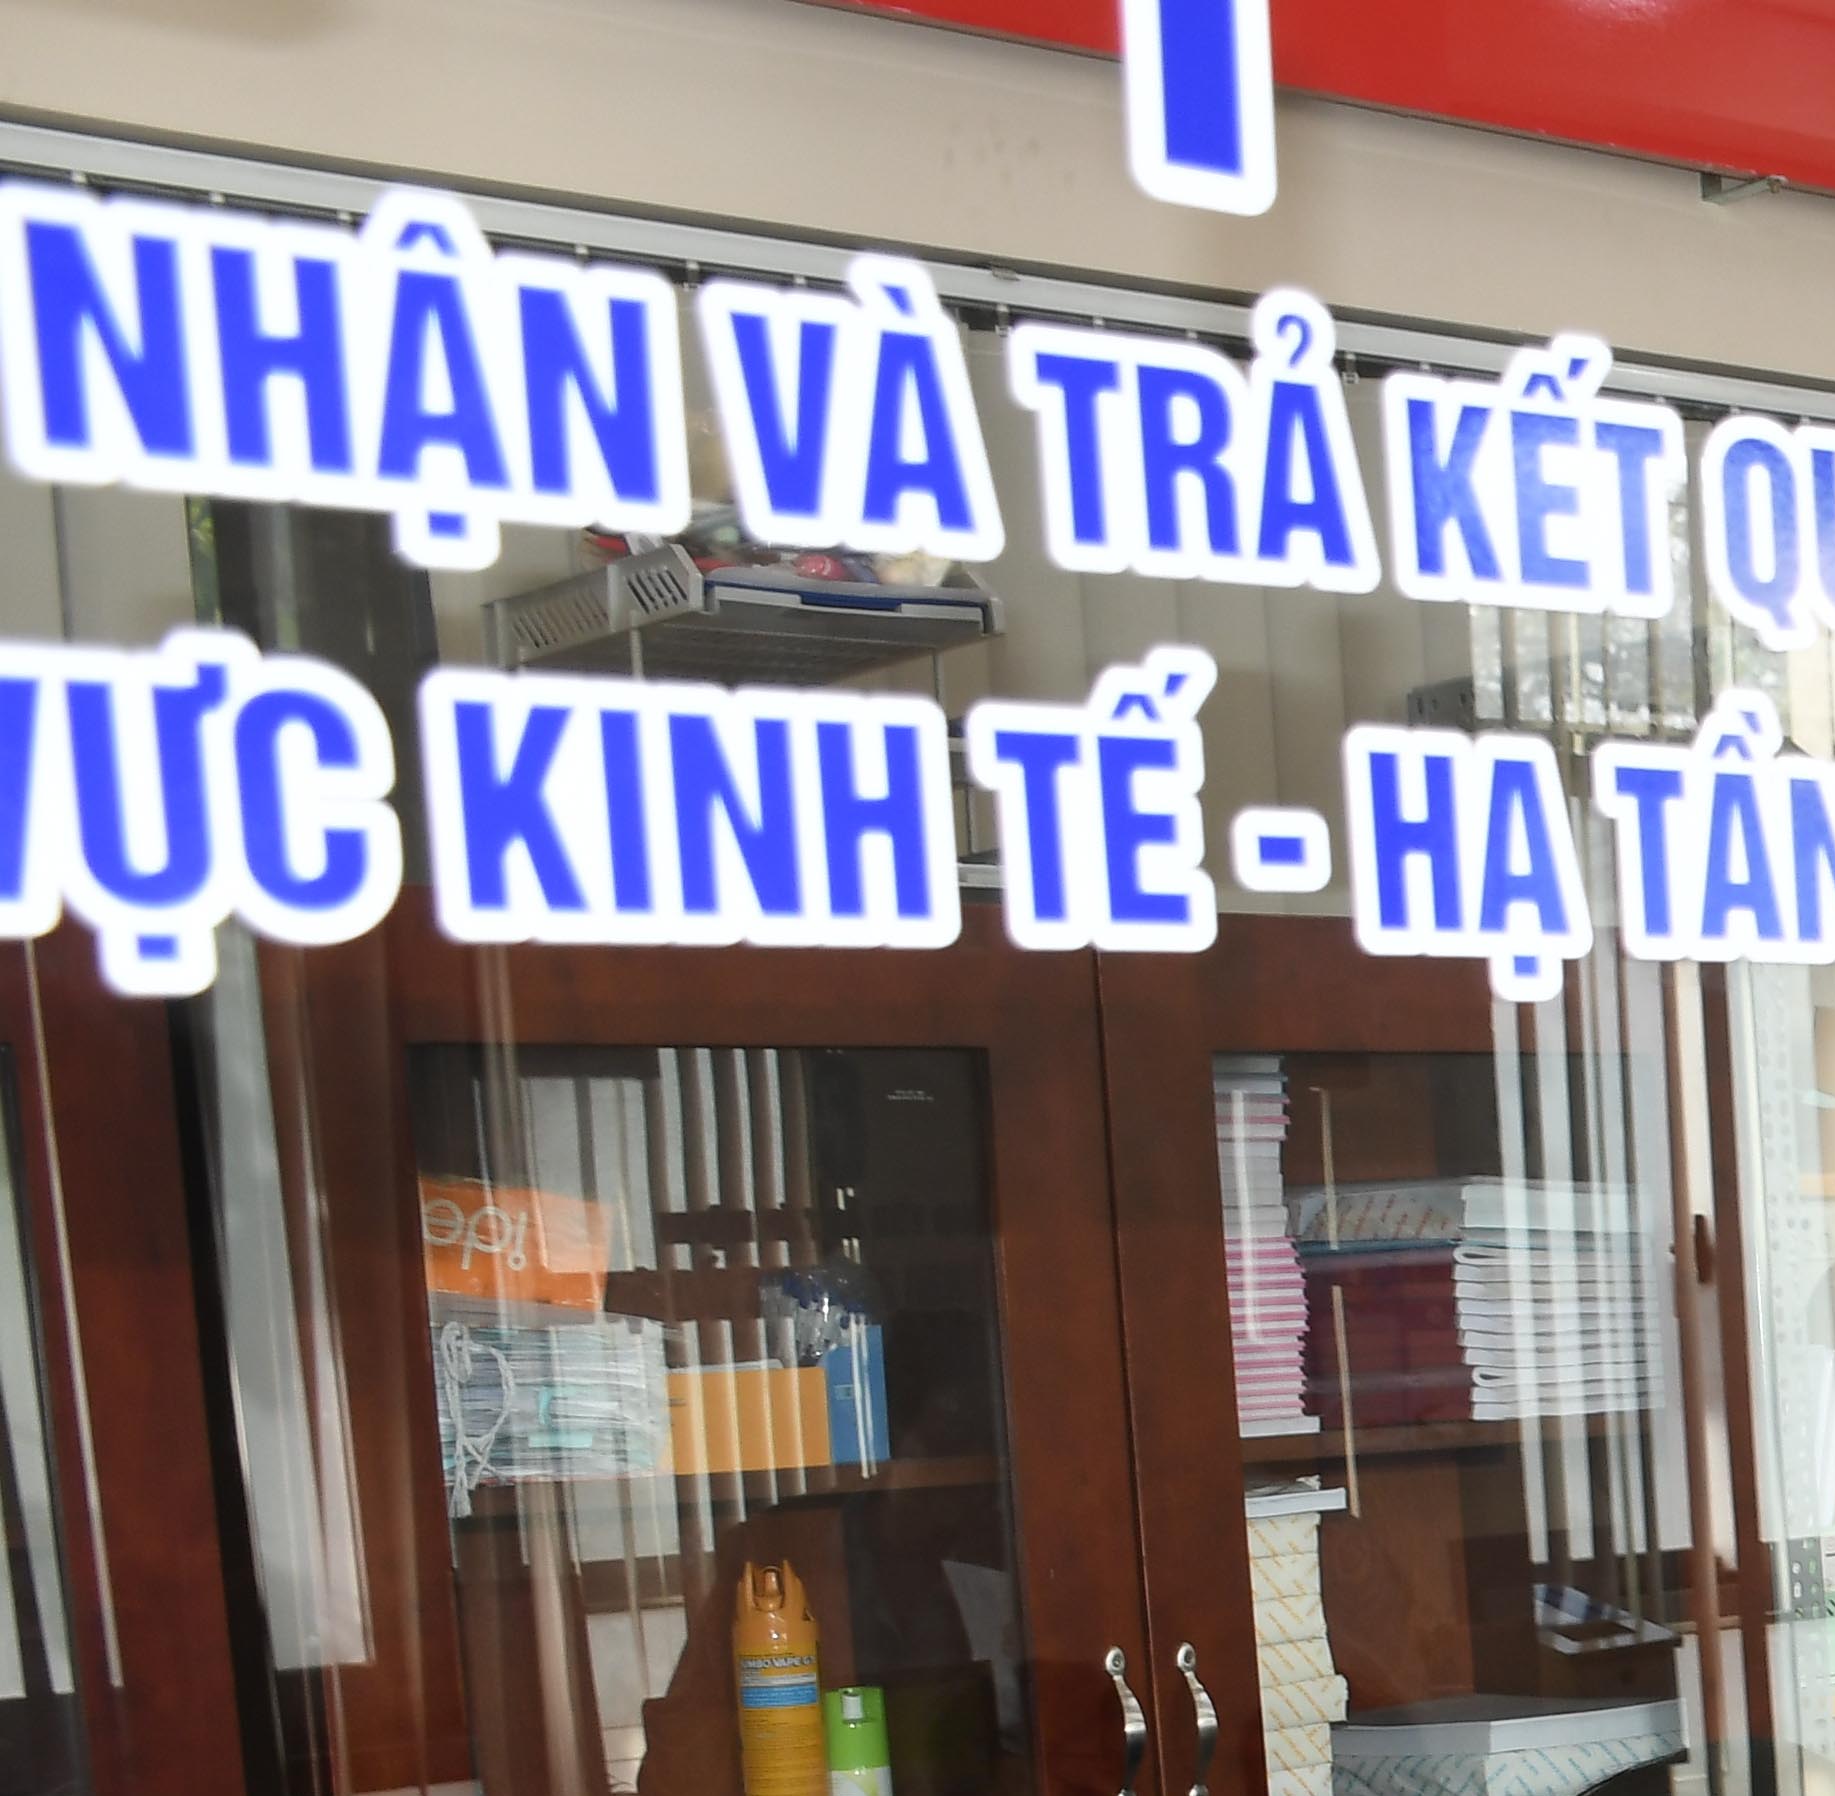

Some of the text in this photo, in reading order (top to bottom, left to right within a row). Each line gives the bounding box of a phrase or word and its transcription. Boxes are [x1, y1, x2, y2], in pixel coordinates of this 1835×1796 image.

[25, 220, 658, 537] NHẬN
[730, 284, 973, 530] VÀ
[1035, 312, 1353, 566] TRẢ
[1406, 356, 1665, 597] KẾT
[453, 702, 930, 917] KINH
[994, 672, 1190, 923] TẾ
[1258, 836, 1303, 864] -
[1368, 752, 1566, 977] HẠ
